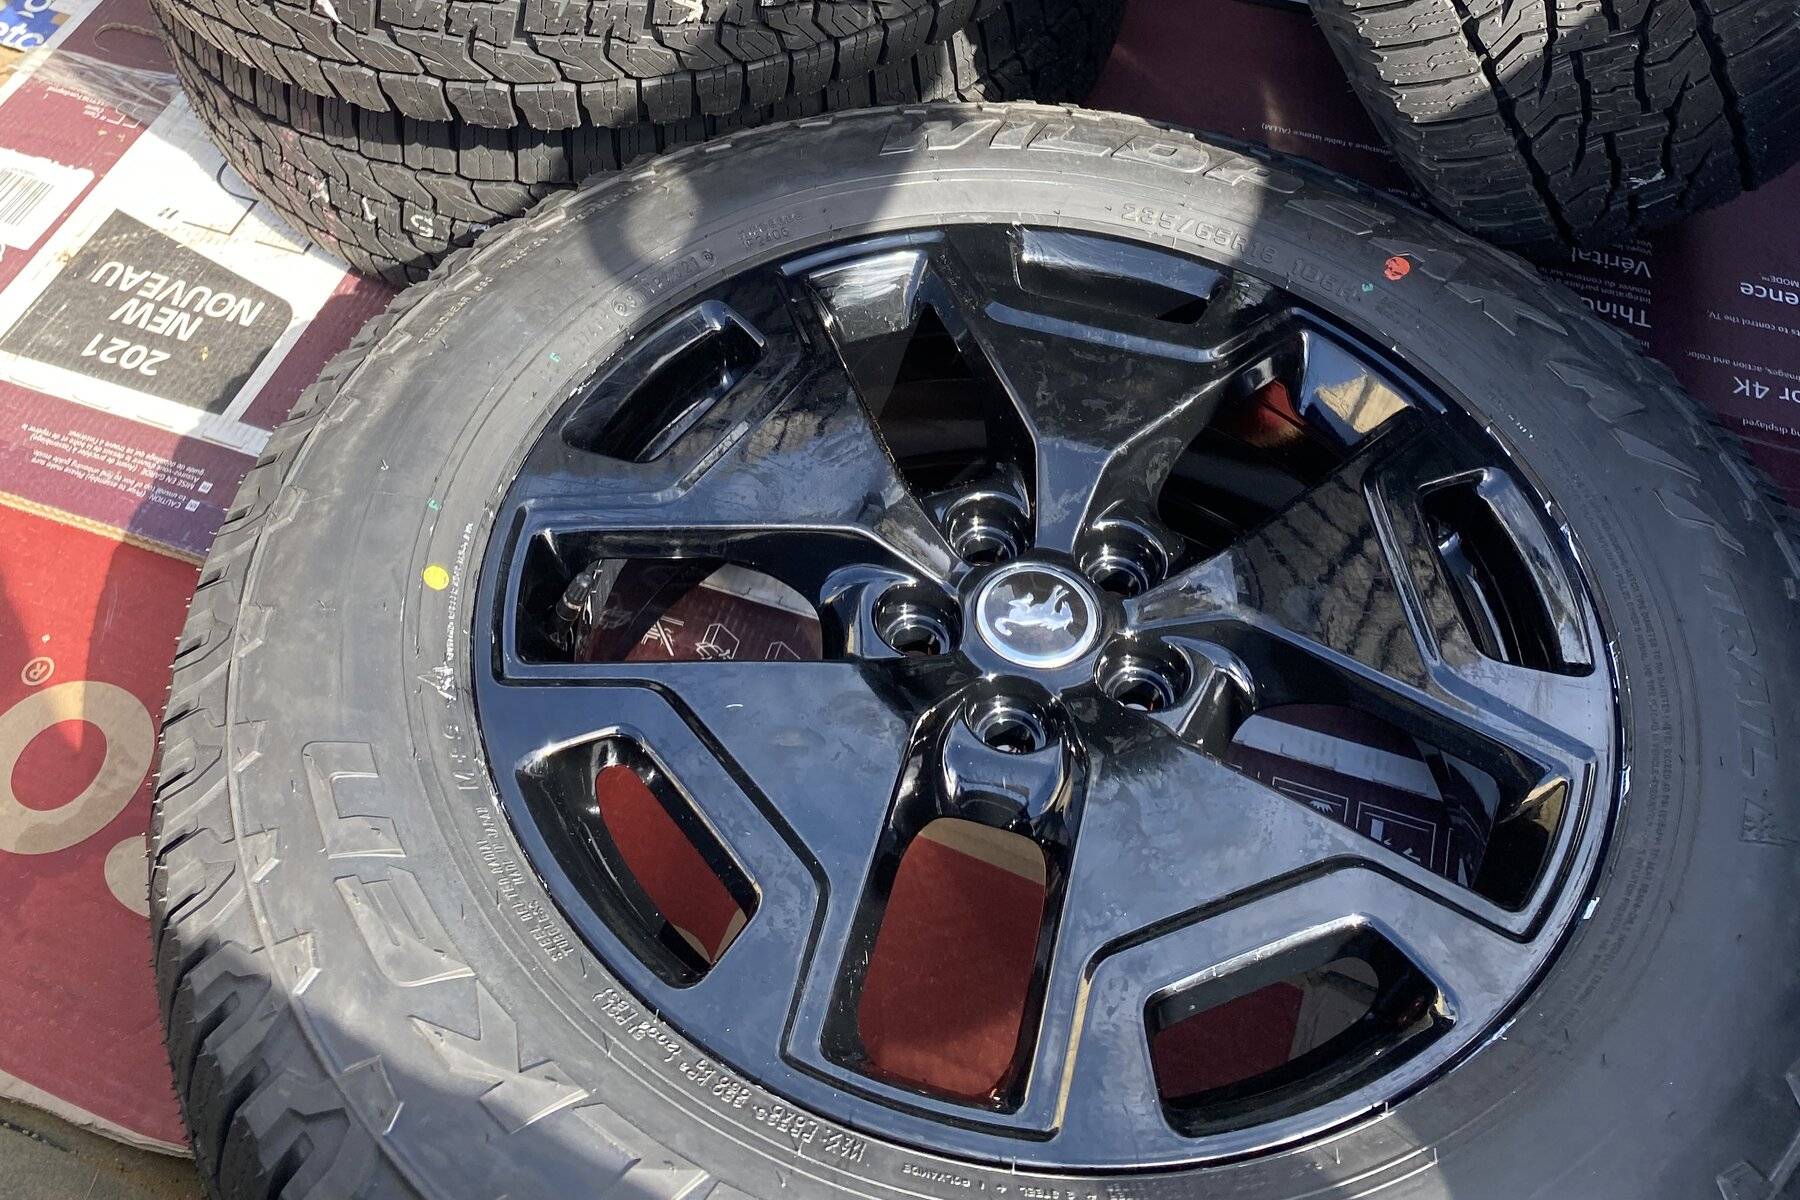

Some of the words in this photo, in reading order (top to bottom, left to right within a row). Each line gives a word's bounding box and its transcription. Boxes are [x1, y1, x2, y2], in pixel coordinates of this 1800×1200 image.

[96, 260, 266, 327] NOUVEAU
[109, 296, 205, 342] NEW
[1723, 313, 1739, 324] the
[1740, 317, 1776, 331] control
[1777, 325, 1788, 333] to
[81, 333, 172, 377] 2021
[1712, 355, 1730, 365] and
[1732, 360, 1762, 373] action
[1730, 376, 1770, 399] 4K
[1741, 417, 1788, 434] displayed
[140, 467, 166, 480] GARDE
[165, 475, 177, 484] EN
[177, 478, 195, 489] MISE
[148, 493, 182, 509] CAUTION
